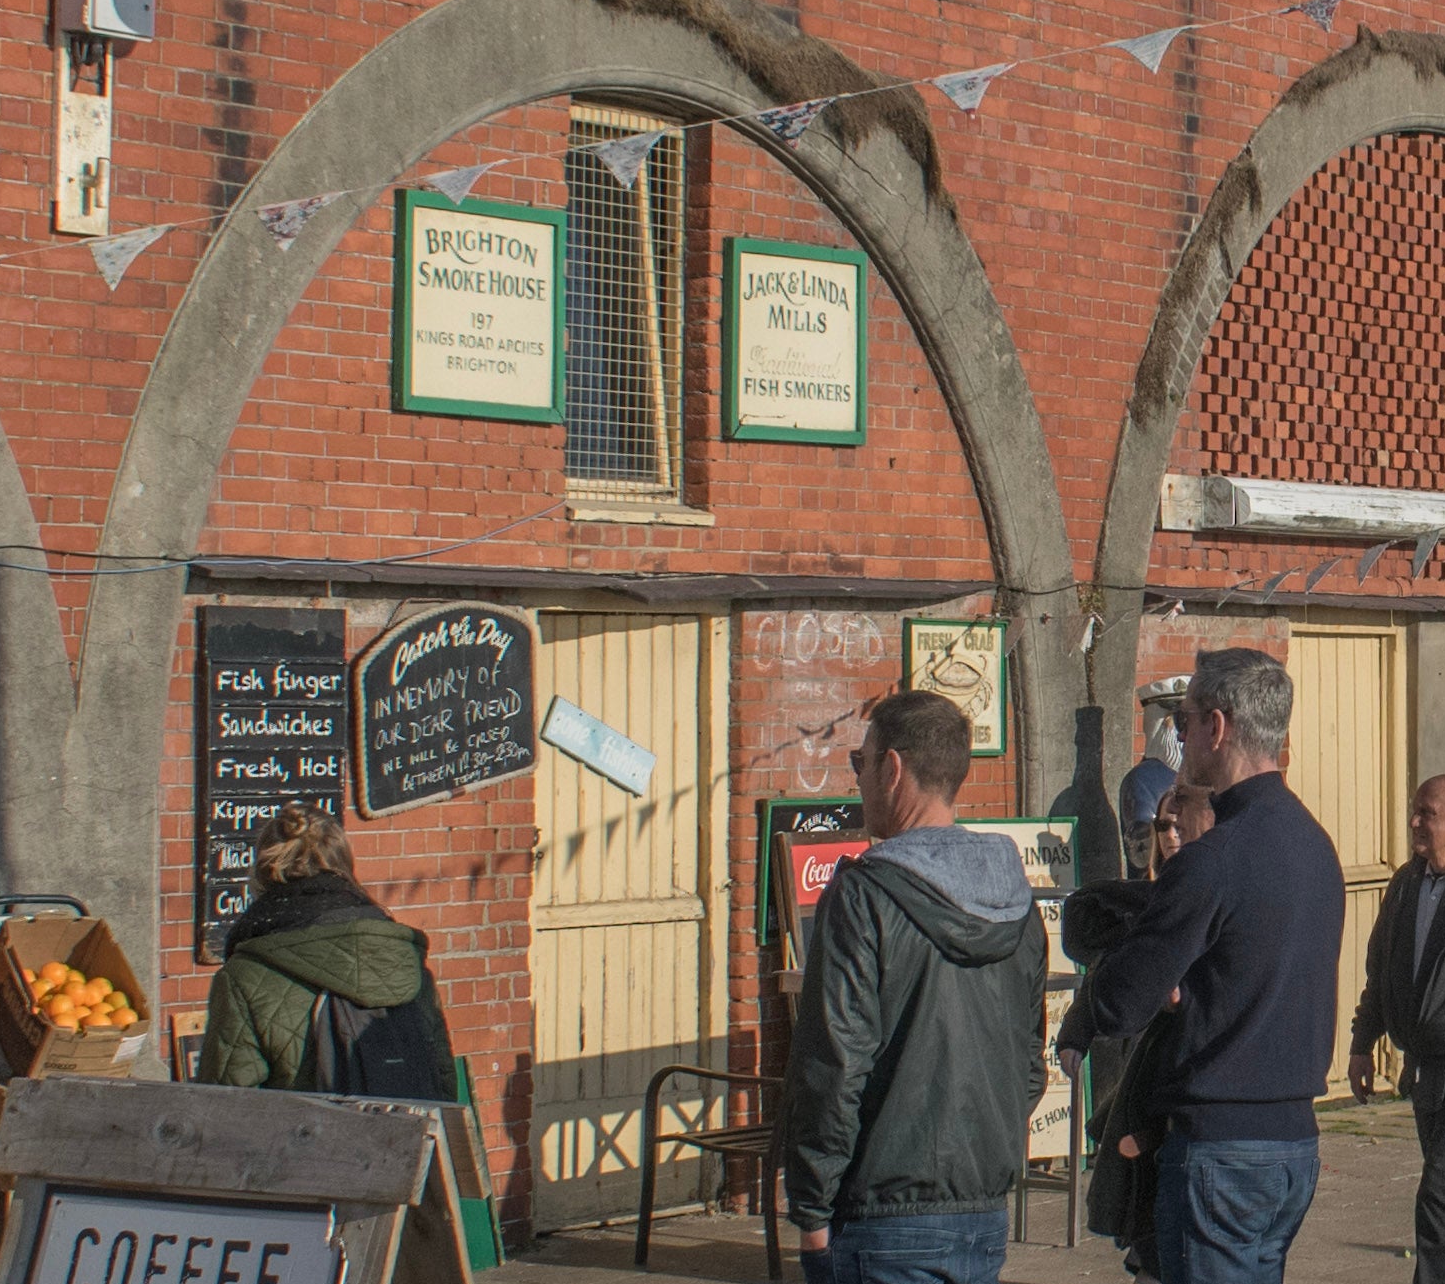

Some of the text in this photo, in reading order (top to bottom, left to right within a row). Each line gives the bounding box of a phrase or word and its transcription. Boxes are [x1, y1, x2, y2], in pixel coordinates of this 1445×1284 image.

[424, 228, 538, 268] BRIGHTON
[470, 312, 495, 331] 197
[766, 303, 828, 334] MILLS
[415, 329, 545, 357] KINGS ROAD ARCHES
[446, 355, 518, 376] BRIGHTON
[743, 376, 852, 403] FISH SMOKERS
[390, 620, 451, 687] Catch
[476, 617, 515, 662] Day
[752, 612, 885, 672] CLOSED
[917, 632, 995, 652] FRESH CRAB
[216, 663, 343, 699] Fish finger
[372, 660, 502, 720] IN MEMORY OF
[219, 708, 334, 738] Sandwiches
[408, 708, 455, 744] DEAR
[464, 686, 523, 727] FRIEND
[216, 755, 339, 782] Fresh, Hot
[409, 748, 439, 767] WILL
[402, 763, 456, 792] BETWEEN
[212, 799, 282, 831] Kipper
[1020, 843, 1072, 866] INDA'S
